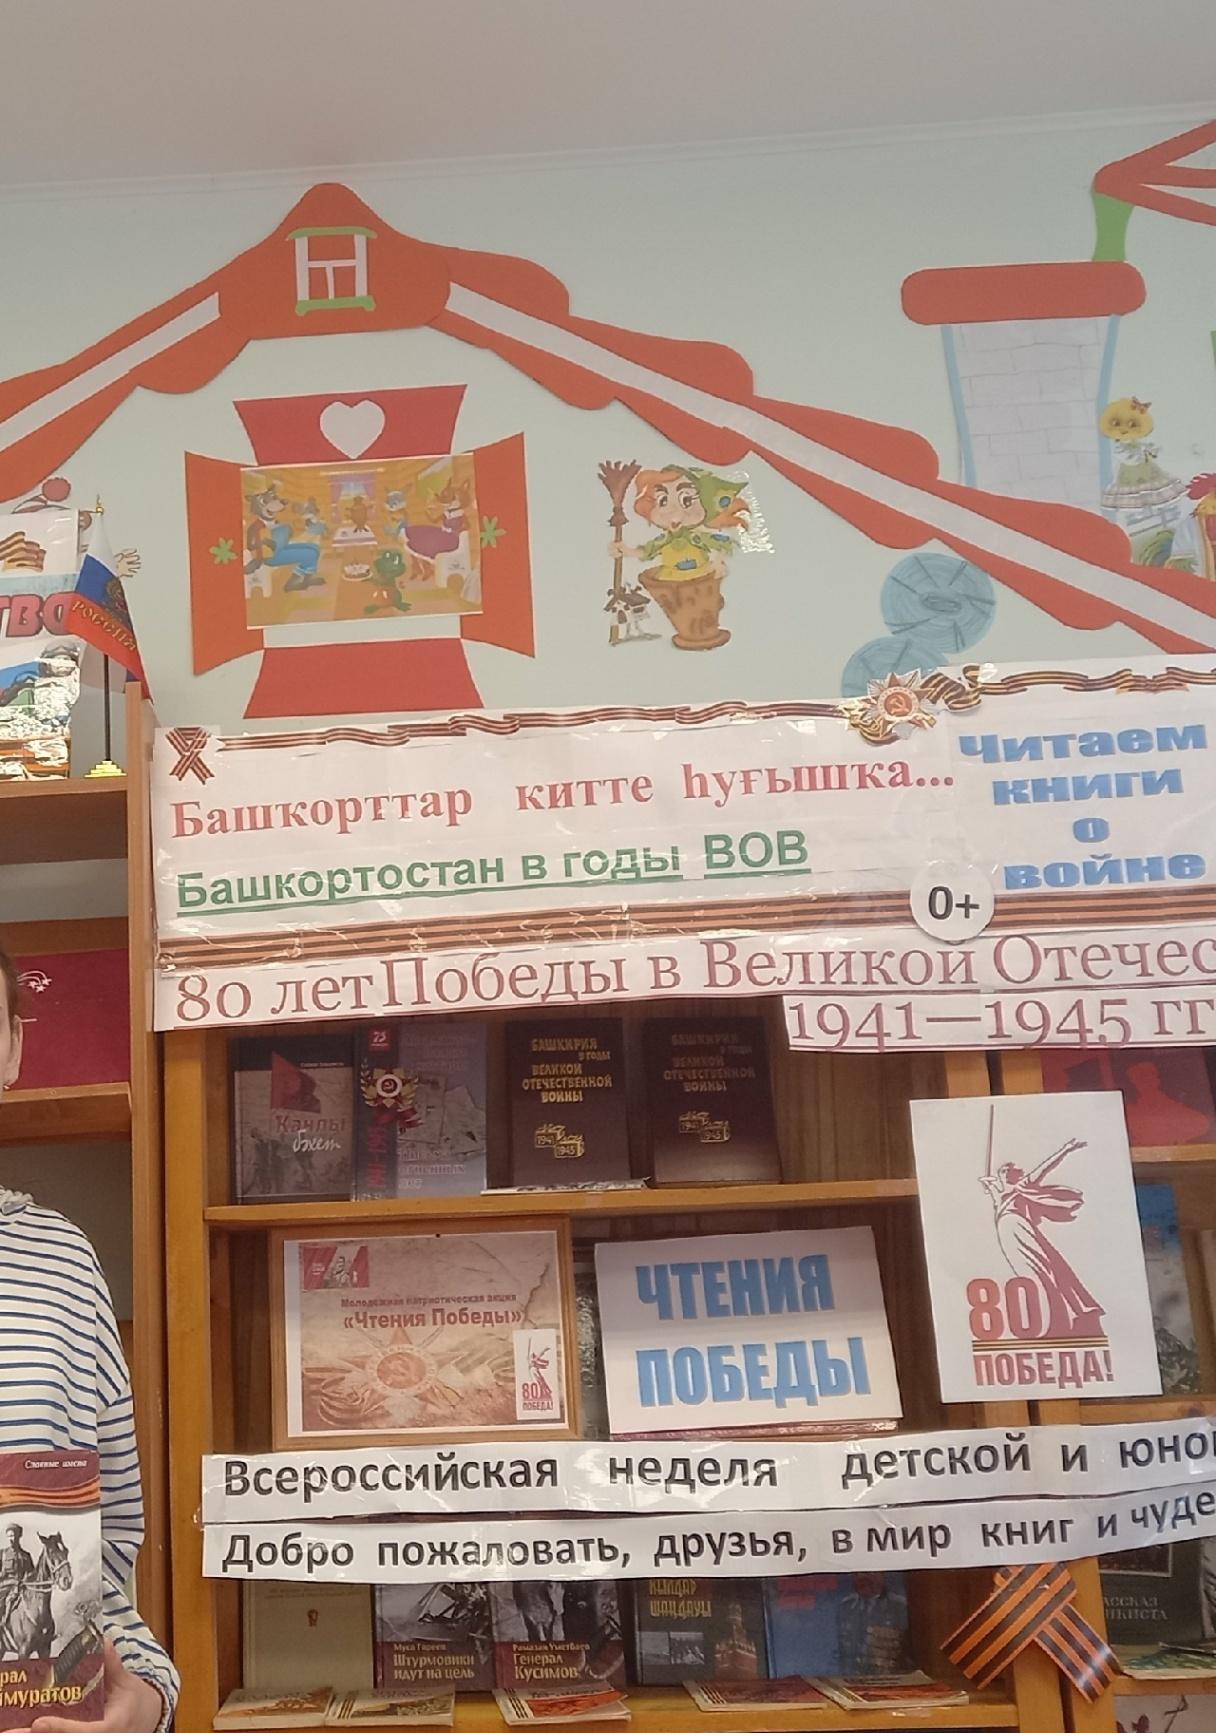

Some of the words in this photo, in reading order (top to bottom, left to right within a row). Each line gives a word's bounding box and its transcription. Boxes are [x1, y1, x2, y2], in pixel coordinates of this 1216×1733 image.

[959, 723, 1207, 765] Читаем
[515, 774, 654, 811] китте
[993, 767, 1184, 806] книги
[177, 853, 505, 908] Башкортостан
[521, 854, 547, 881] в
[563, 844, 680, 884] годы
[704, 829, 808, 870] ВОВ
[1004, 852, 1207, 890] войне
[928, 886, 980, 921] 0+
[176, 972, 252, 1023] 80
[270, 972, 374, 1015] лет
[382, 952, 627, 1009] Победы
[647, 958, 682, 990] в
[993, 934, 1216, 987] Отечес
[532, 1037, 598, 1051] БАШКИРИЯ
[522, 1073, 613, 1090] ОТЕЧЕСТВЕННОЙ
[532, 1062, 582, 1076] ВЕЛИКОЙ
[541, 1090, 584, 1103] ВОЙНЫ
[635, 1253, 836, 1321] ЧТЕНИЯ
[344, 1310, 426, 1330] «Чтения
[432, 1307, 522, 1330] Победы»
[966, 1276, 1048, 1341] 80
[636, 1336, 871, 1408] ПОБЕДЫ
[972, 1348, 1115, 1389] ПОБЕДА!
[522, 1382, 539, 1400] 80
[522, 1400, 554, 1412] ПОБЕДА!
[224, 1451, 558, 1503] Всероссийская
[609, 1454, 778, 1494] неделя
[841, 1432, 1031, 1490] детской
[1062, 1443, 1088, 1472] и
[1119, 1430, 1216, 1468] юно
[222, 1531, 355, 1573] Добро
[378, 1534, 631, 1568] пожаловать,
[654, 1528, 807, 1568] друзья,
[832, 1528, 852, 1554] в
[866, 1521, 952, 1557] мир
[981, 1514, 1074, 1548] книг
[1098, 1512, 1118, 1538] и
[393, 1654, 475, 1669] Штурмовики
[394, 1669, 425, 1681] идут
[426, 1669, 444, 1679] на
[445, 1669, 475, 1680] цель
[513, 1653, 563, 1667] Генерал
[515, 1666, 579, 1682] Кусимов
